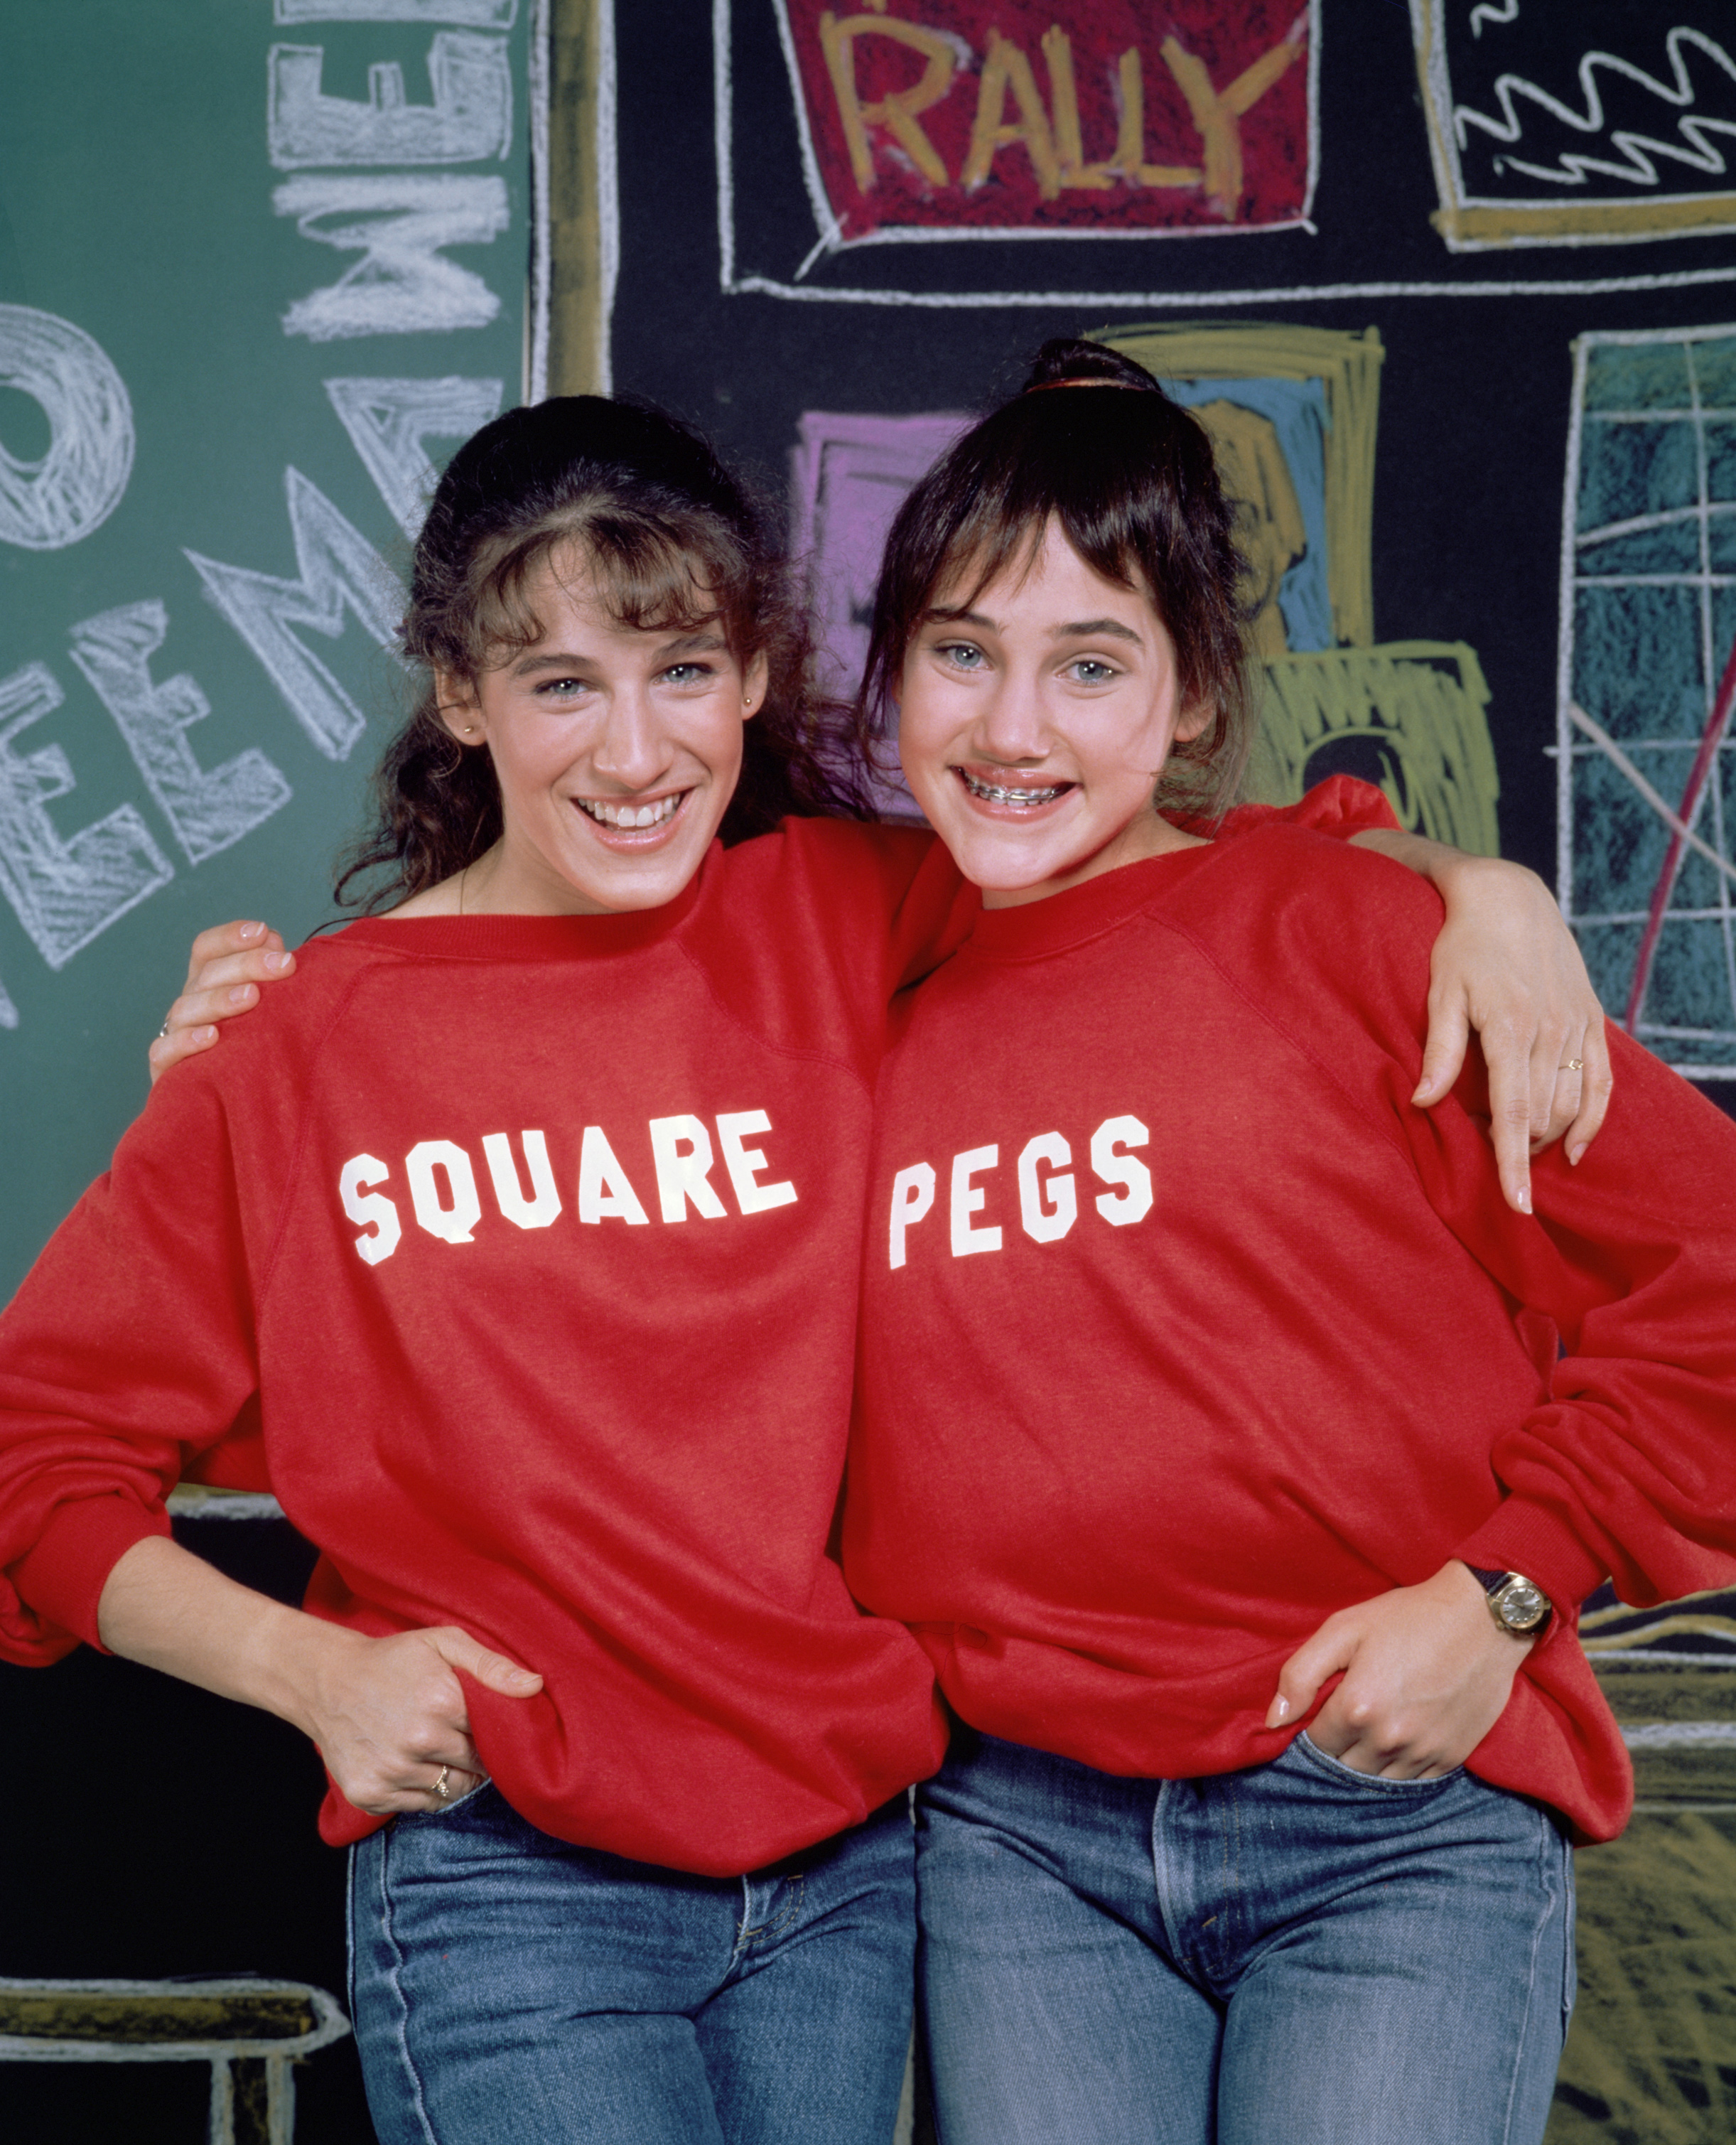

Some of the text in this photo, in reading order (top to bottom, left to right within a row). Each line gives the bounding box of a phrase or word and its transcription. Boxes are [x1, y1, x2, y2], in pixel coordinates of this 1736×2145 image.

[819, 10, 1306, 220] RALLY
[339, 1109, 798, 1266] SQUARE
[889, 1114, 1154, 1270] PEGS
